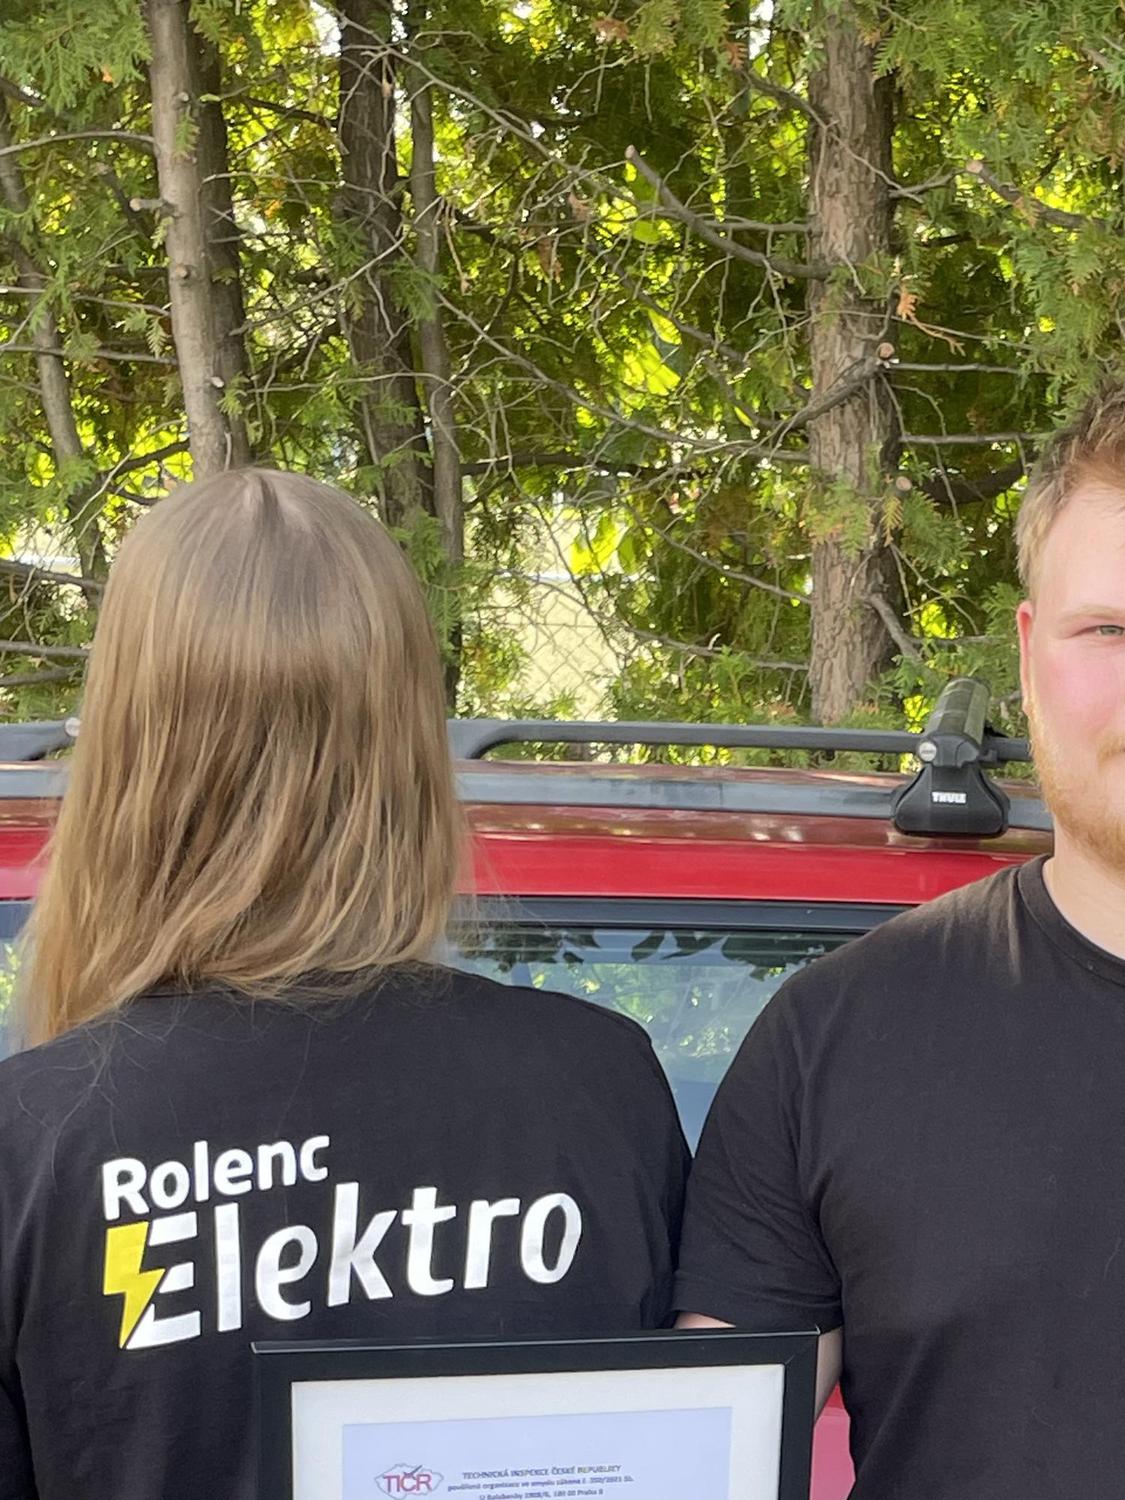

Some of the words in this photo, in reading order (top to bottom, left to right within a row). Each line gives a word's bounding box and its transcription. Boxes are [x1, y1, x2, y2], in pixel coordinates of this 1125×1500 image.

[102, 1135, 329, 1220] Rolenc
[103, 1182, 582, 1350] Elektro
[383, 1466, 432, 1494] TIČR
